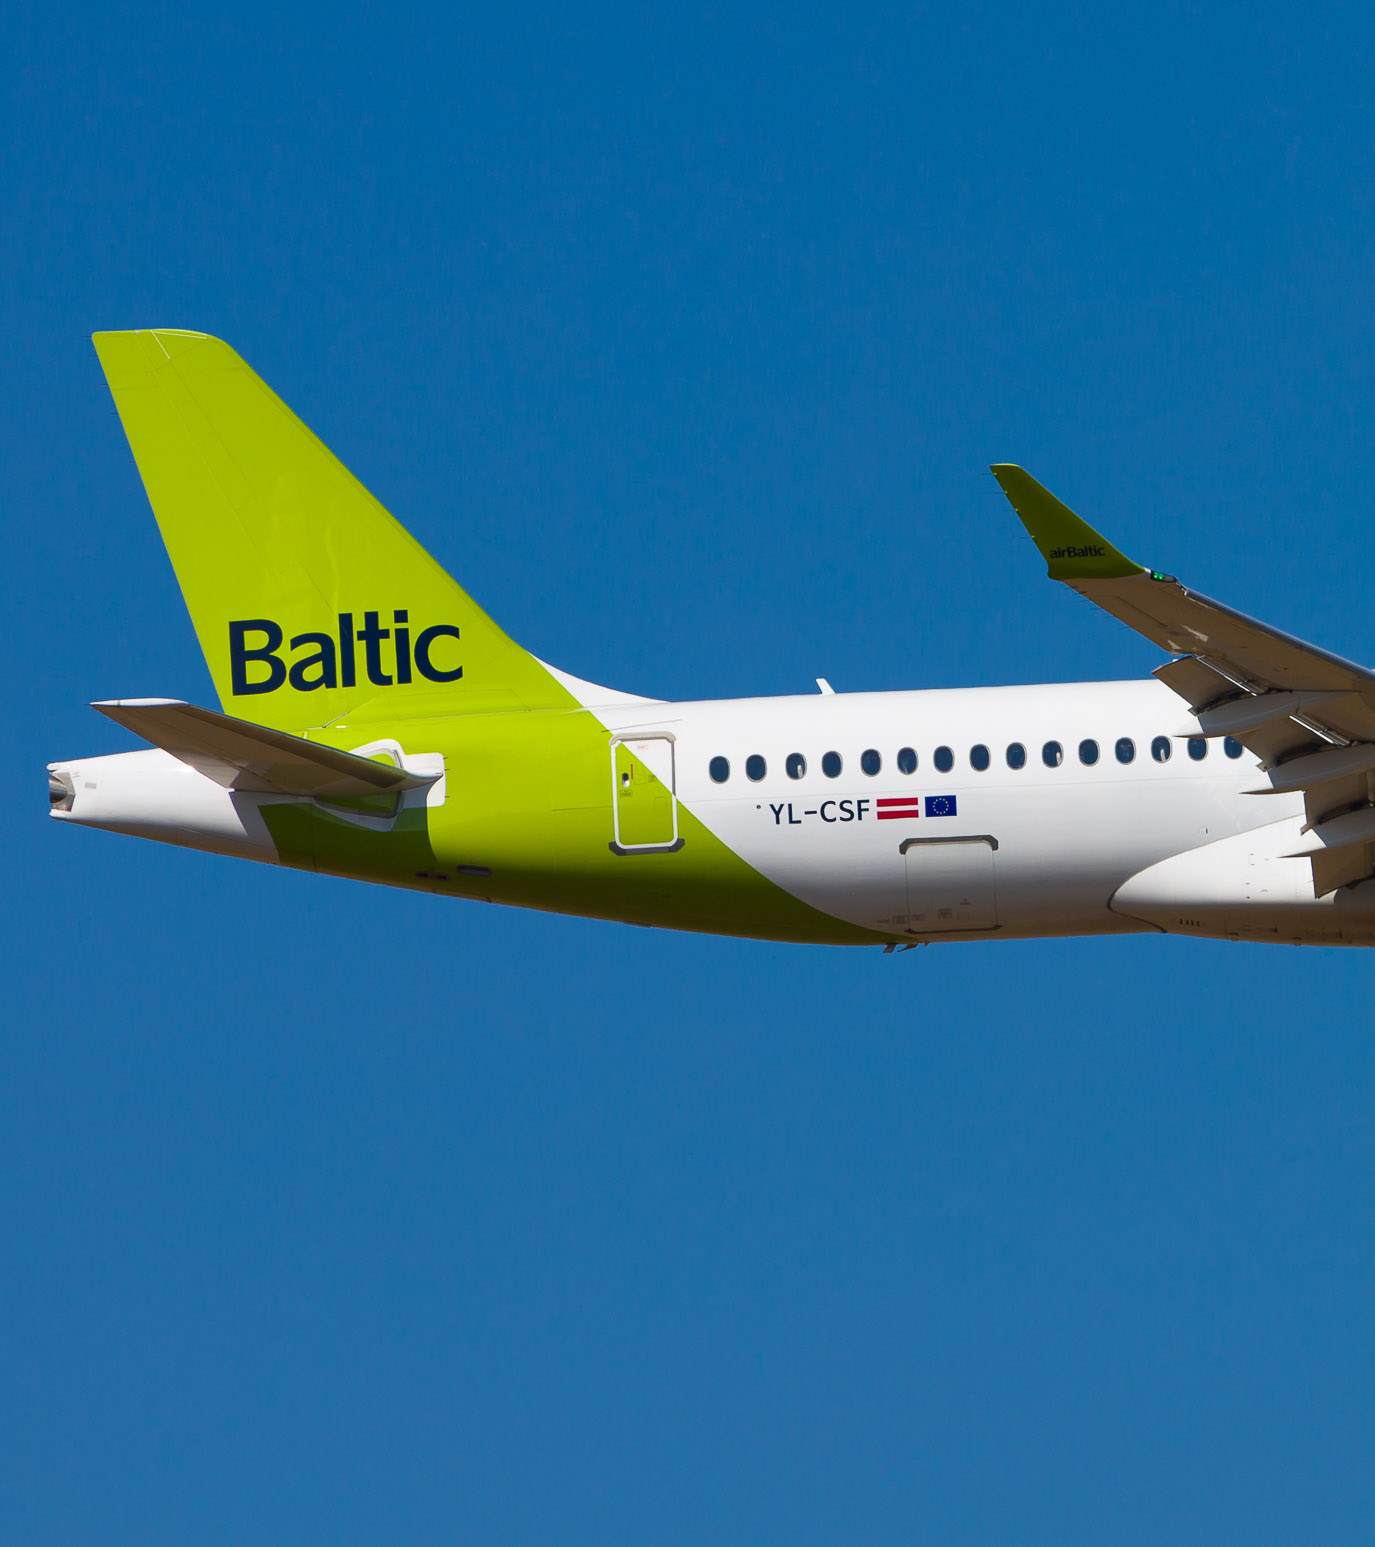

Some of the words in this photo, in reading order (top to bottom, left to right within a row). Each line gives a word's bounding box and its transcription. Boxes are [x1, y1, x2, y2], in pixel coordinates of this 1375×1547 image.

[1050, 546, 1105, 559] airBaltic
[228, 609, 464, 696] Baltic
[769, 799, 870, 825] YL-CSF
